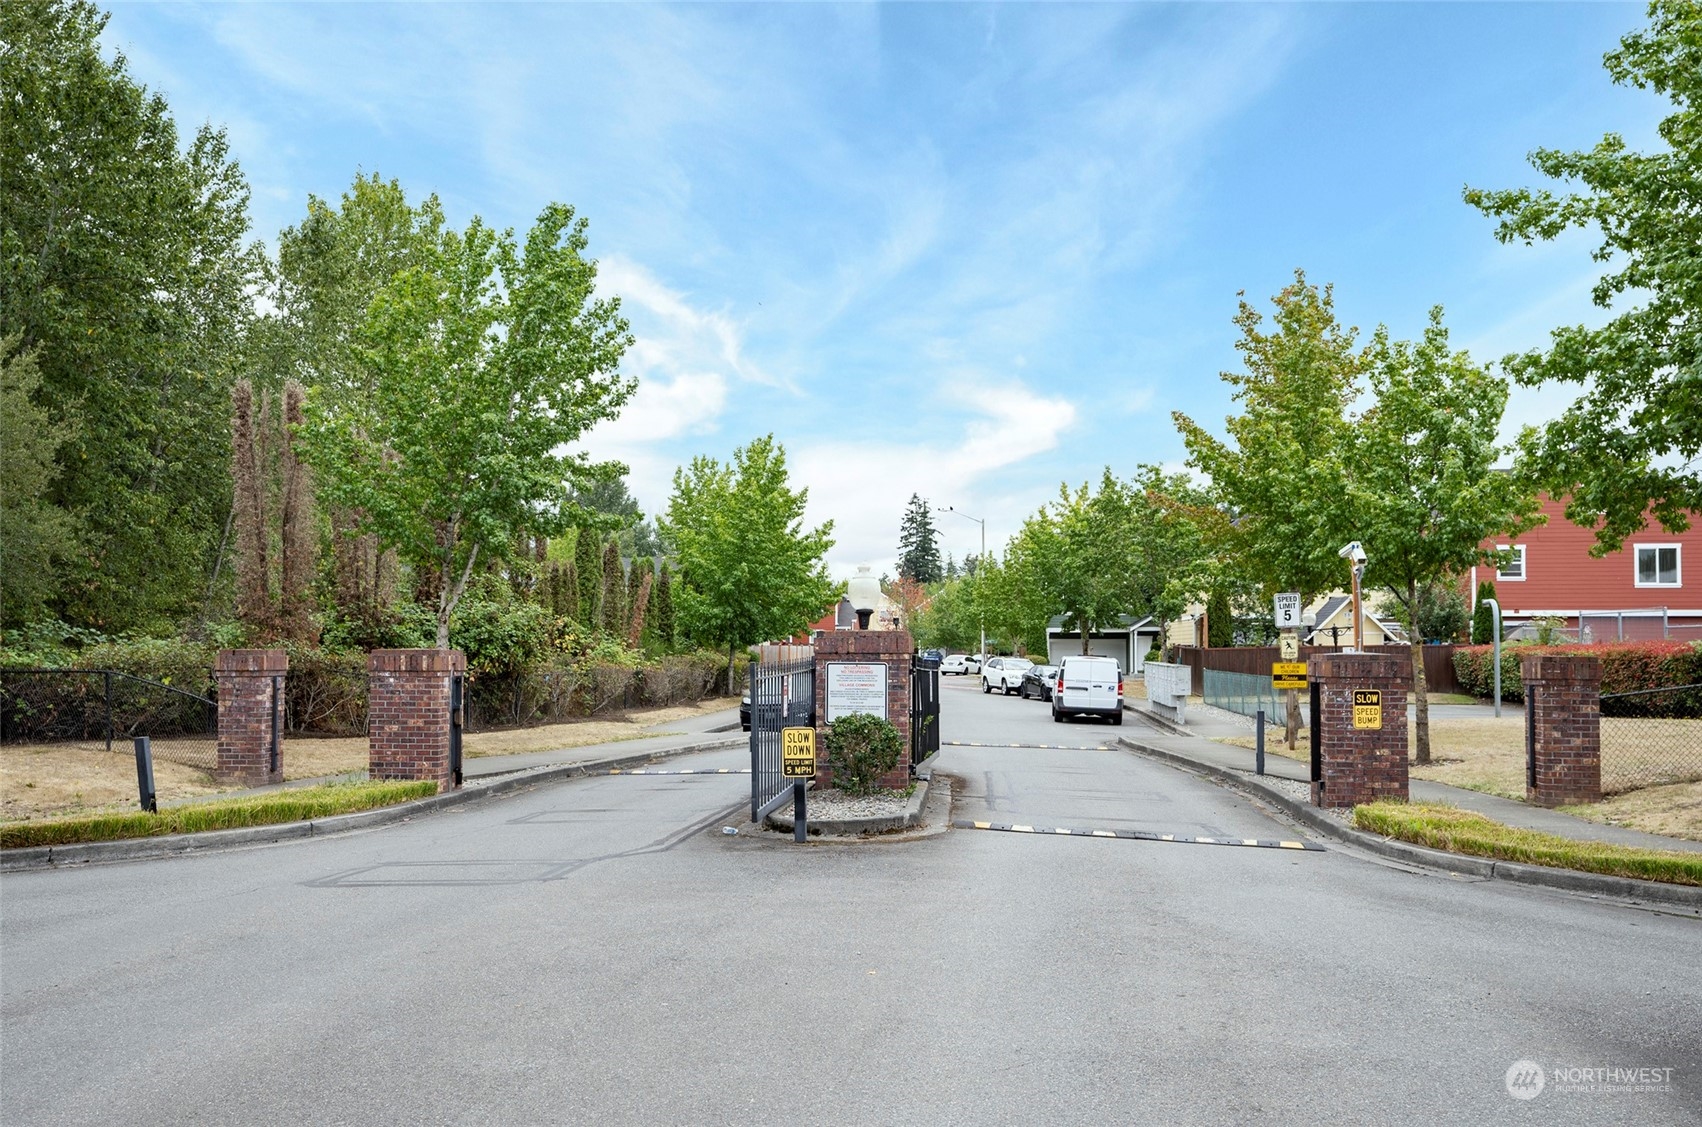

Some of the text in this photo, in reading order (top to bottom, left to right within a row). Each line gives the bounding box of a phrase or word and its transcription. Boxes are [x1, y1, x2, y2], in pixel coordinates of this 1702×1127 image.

[1284, 610, 1292, 621] 5
[1356, 694, 1378, 703] SLOW
[1356, 708, 1378, 716] SPEED
[788, 732, 810, 743] SLOW
[787, 745, 810, 756] DOWN
